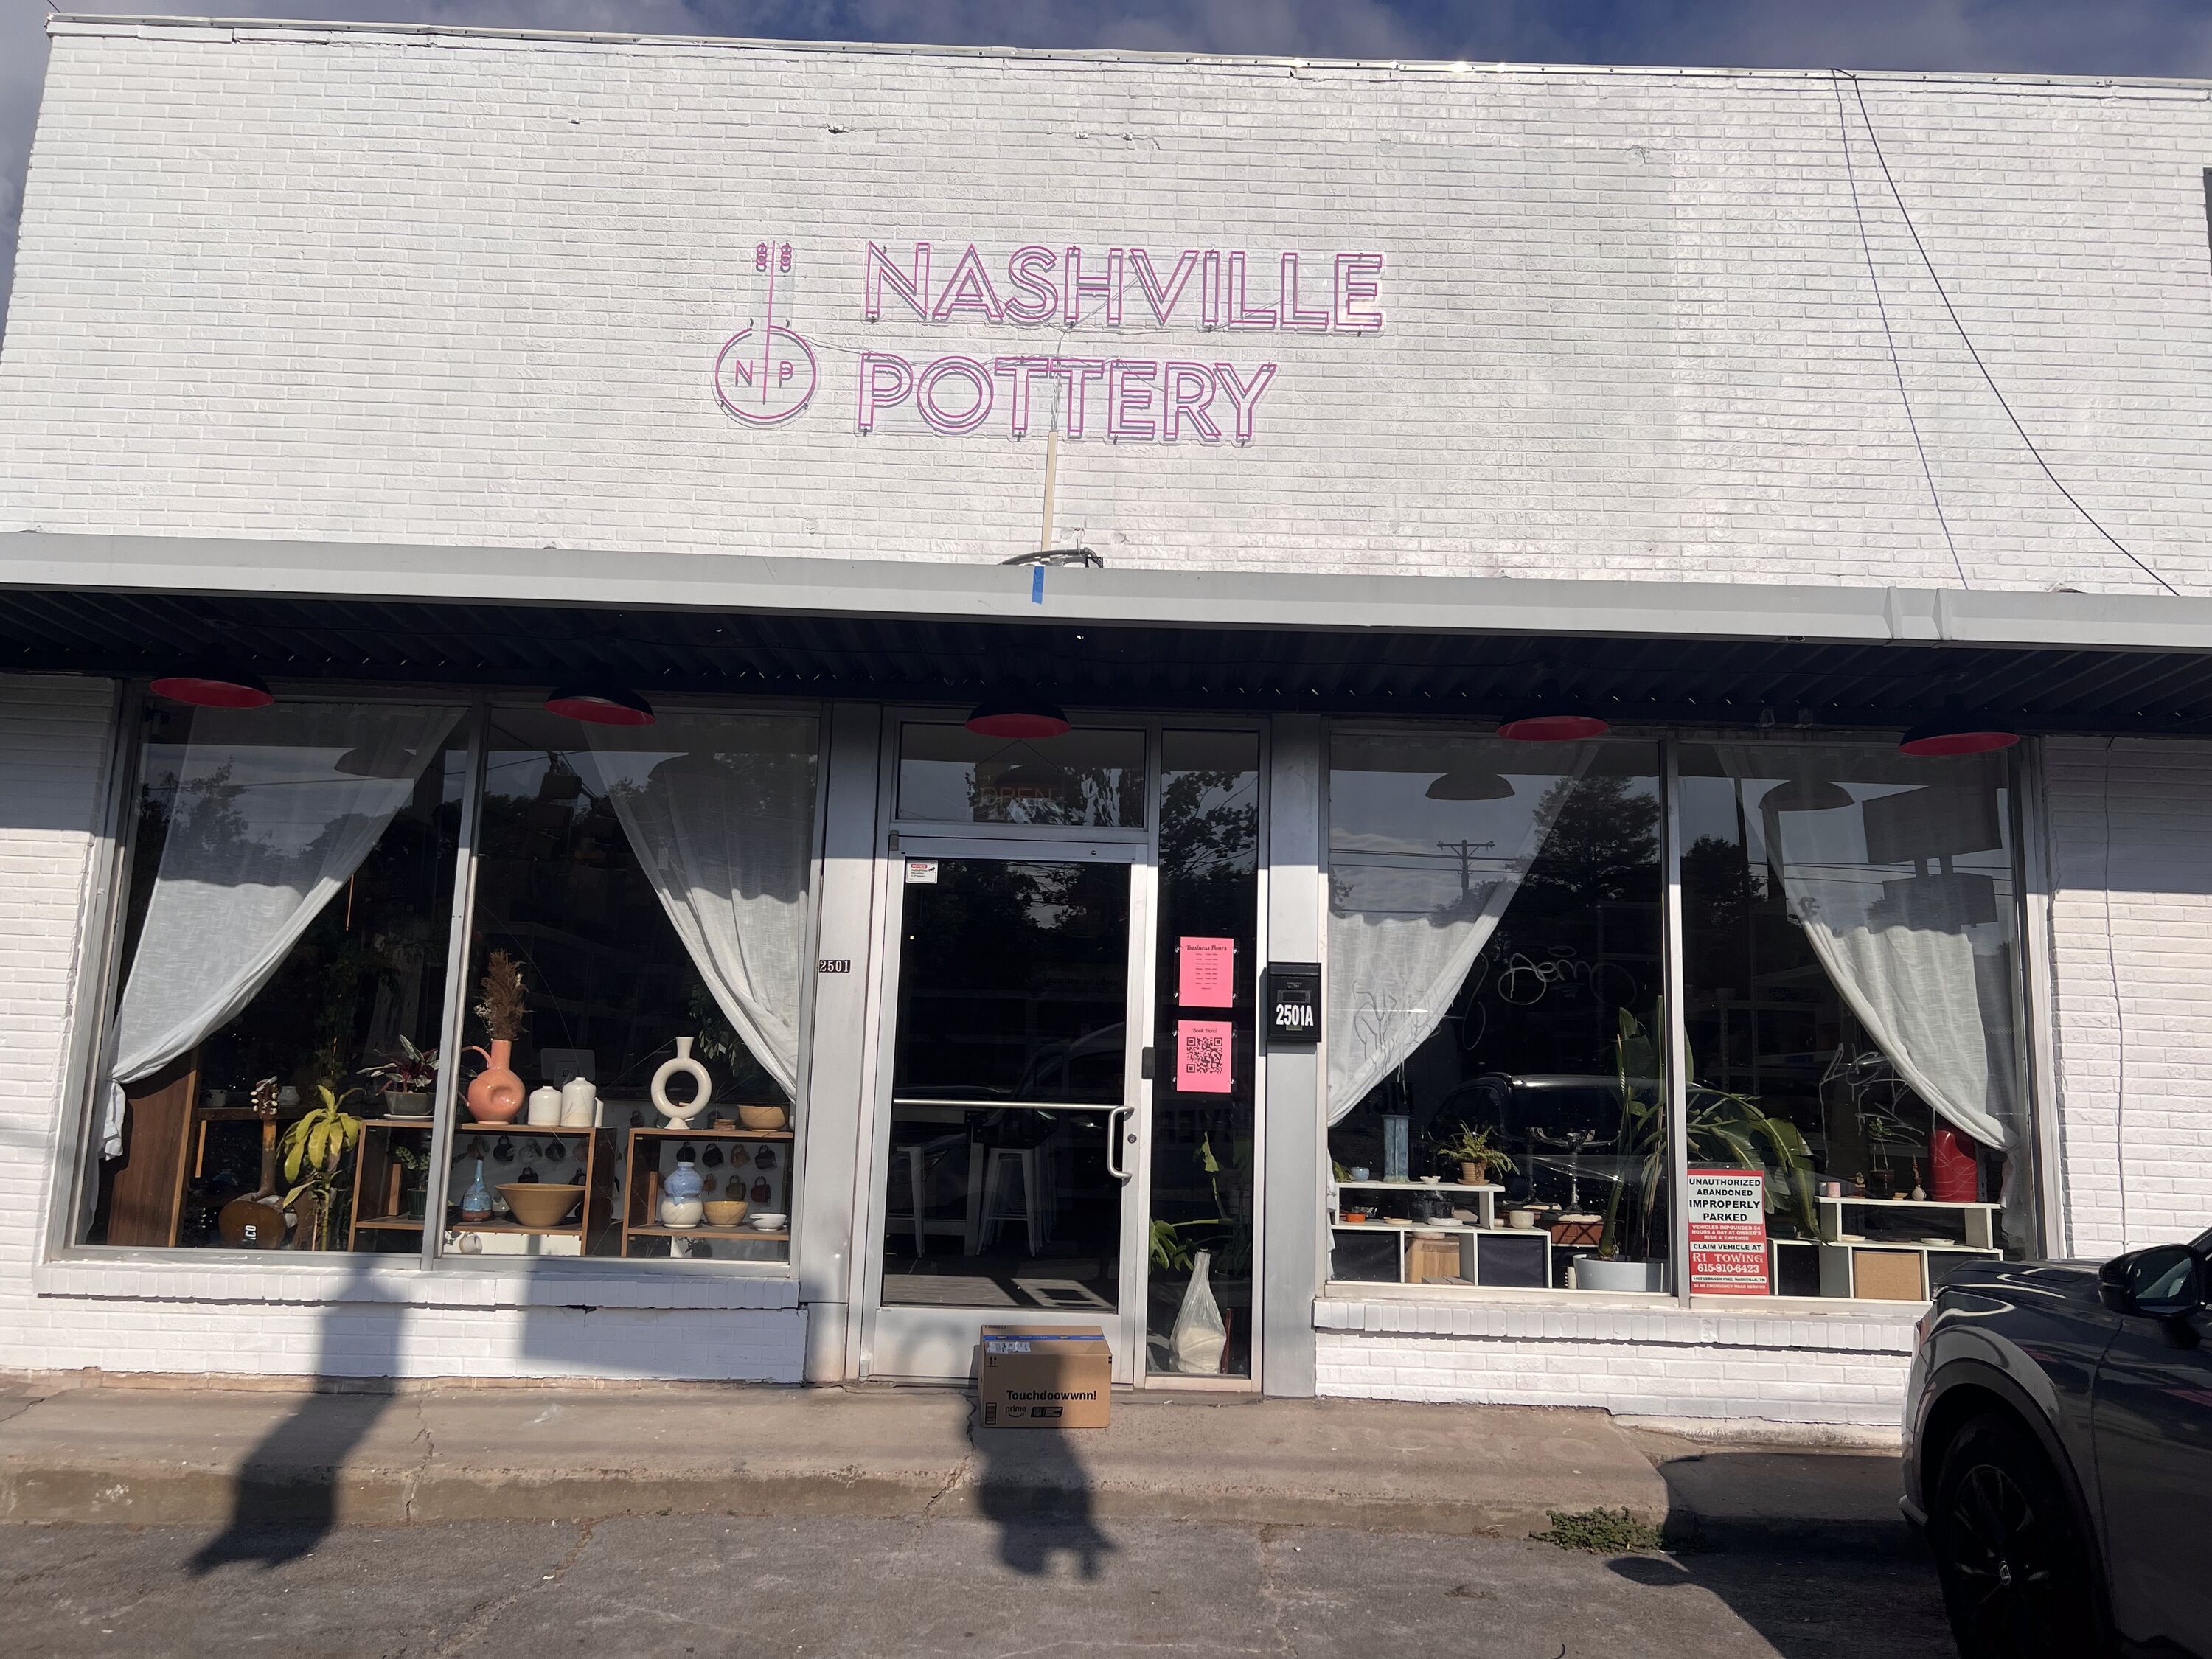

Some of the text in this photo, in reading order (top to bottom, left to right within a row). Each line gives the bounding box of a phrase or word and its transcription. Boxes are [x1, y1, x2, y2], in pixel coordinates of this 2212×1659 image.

[865, 241, 1383, 330] NASHVILLE
[858, 352, 1276, 441] POTTERY
[820, 960, 848, 972] 2501
[1276, 1004, 1314, 1026] 2501A
[1689, 1200, 1760, 1208] IMPROPERLY
[1693, 1253, 1763, 1263] R1 TOWING
[1697, 1264, 1759, 1273] 615-810-6423
[1006, 1390, 1096, 1400] Touchdoowwnn!
[1005, 1405, 1026, 1413] prime
